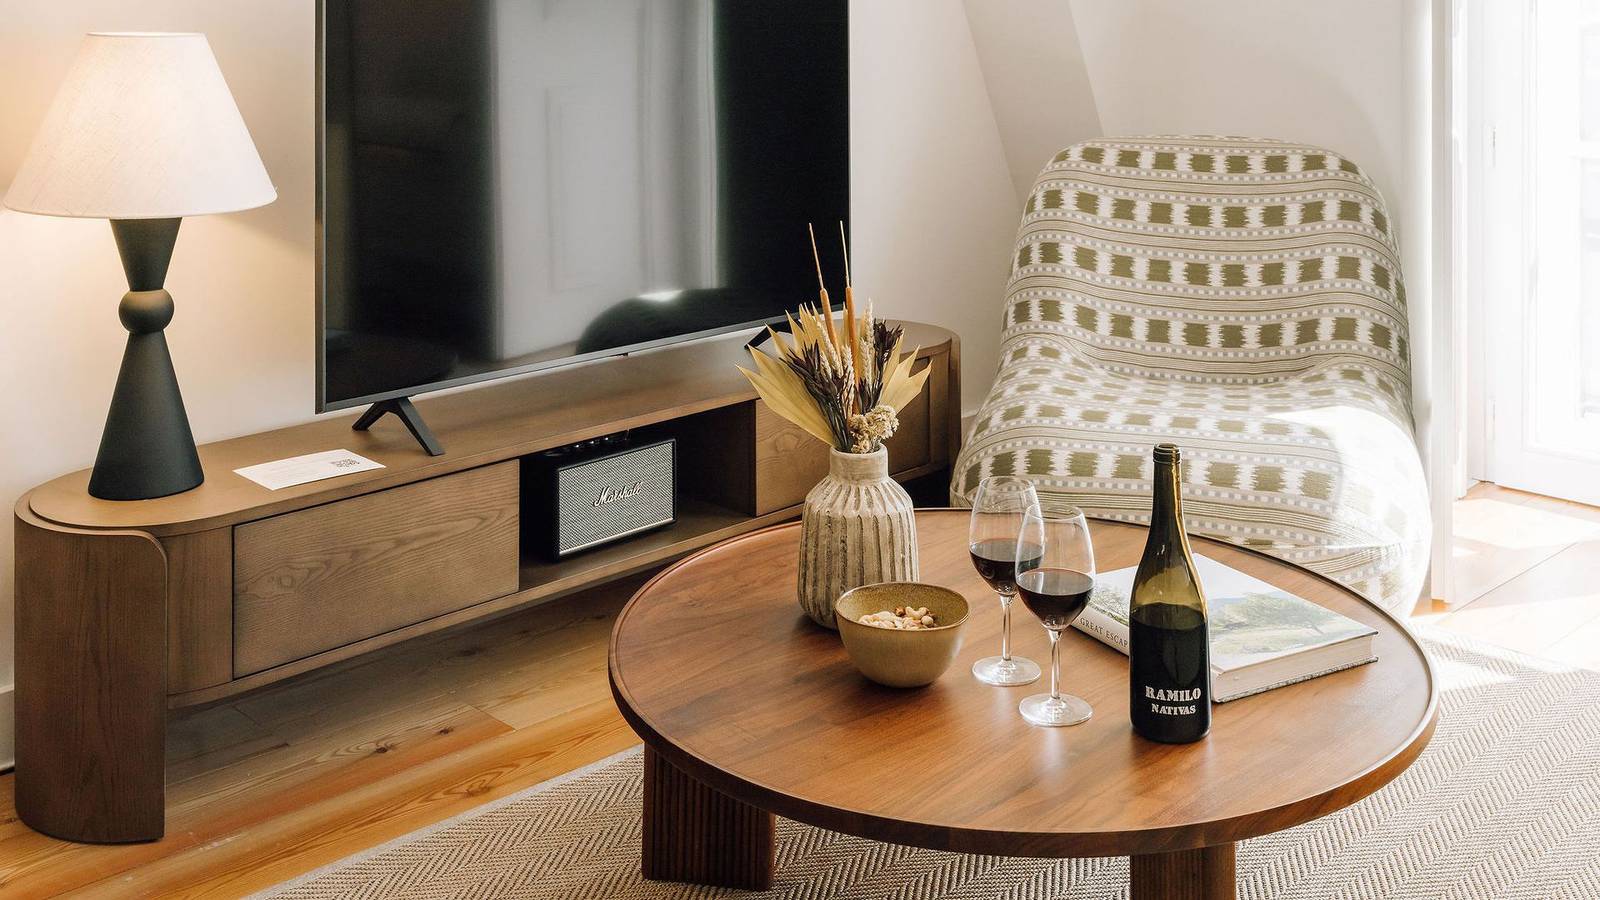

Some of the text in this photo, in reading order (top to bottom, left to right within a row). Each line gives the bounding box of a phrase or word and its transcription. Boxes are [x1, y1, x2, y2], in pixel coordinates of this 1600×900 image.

[594, 481, 643, 507] Marshall
[1079, 617, 1129, 648] GREAT ESCAP
[1145, 685, 1202, 702] RAMILO
[1151, 703, 1197, 716] NATIVAS
